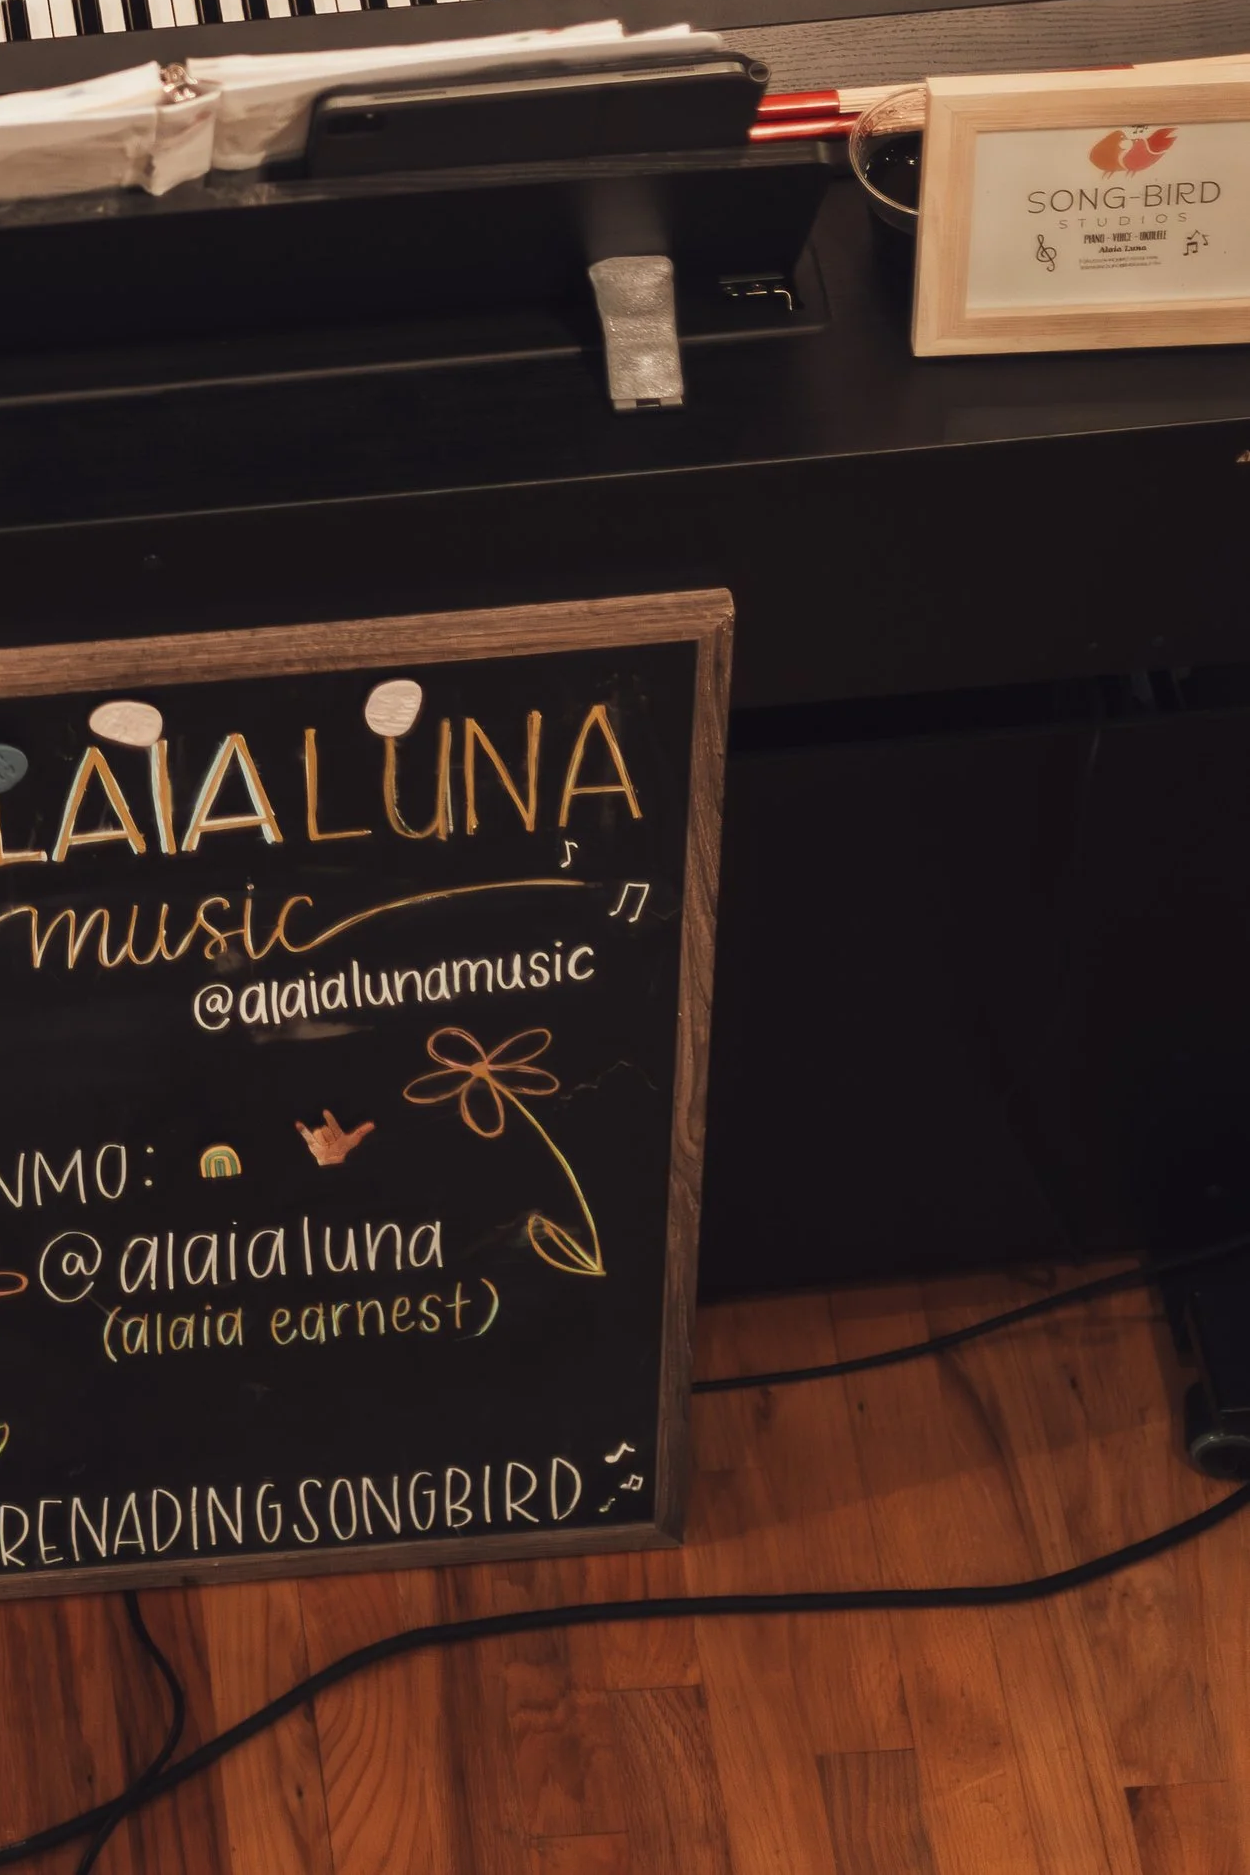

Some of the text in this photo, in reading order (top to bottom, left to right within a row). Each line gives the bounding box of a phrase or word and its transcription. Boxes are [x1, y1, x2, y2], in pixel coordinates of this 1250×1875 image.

[1027, 180, 1222, 215] SONG-BIRD
[1058, 212, 1189, 230] STUDIOS
[1083, 234, 1105, 244] PIANO
[1112, 232, 1132, 242] VOICE
[192, 940, 596, 1031] @alaialunamusic
[103, 1277, 499, 1363] (alaia earnest)
